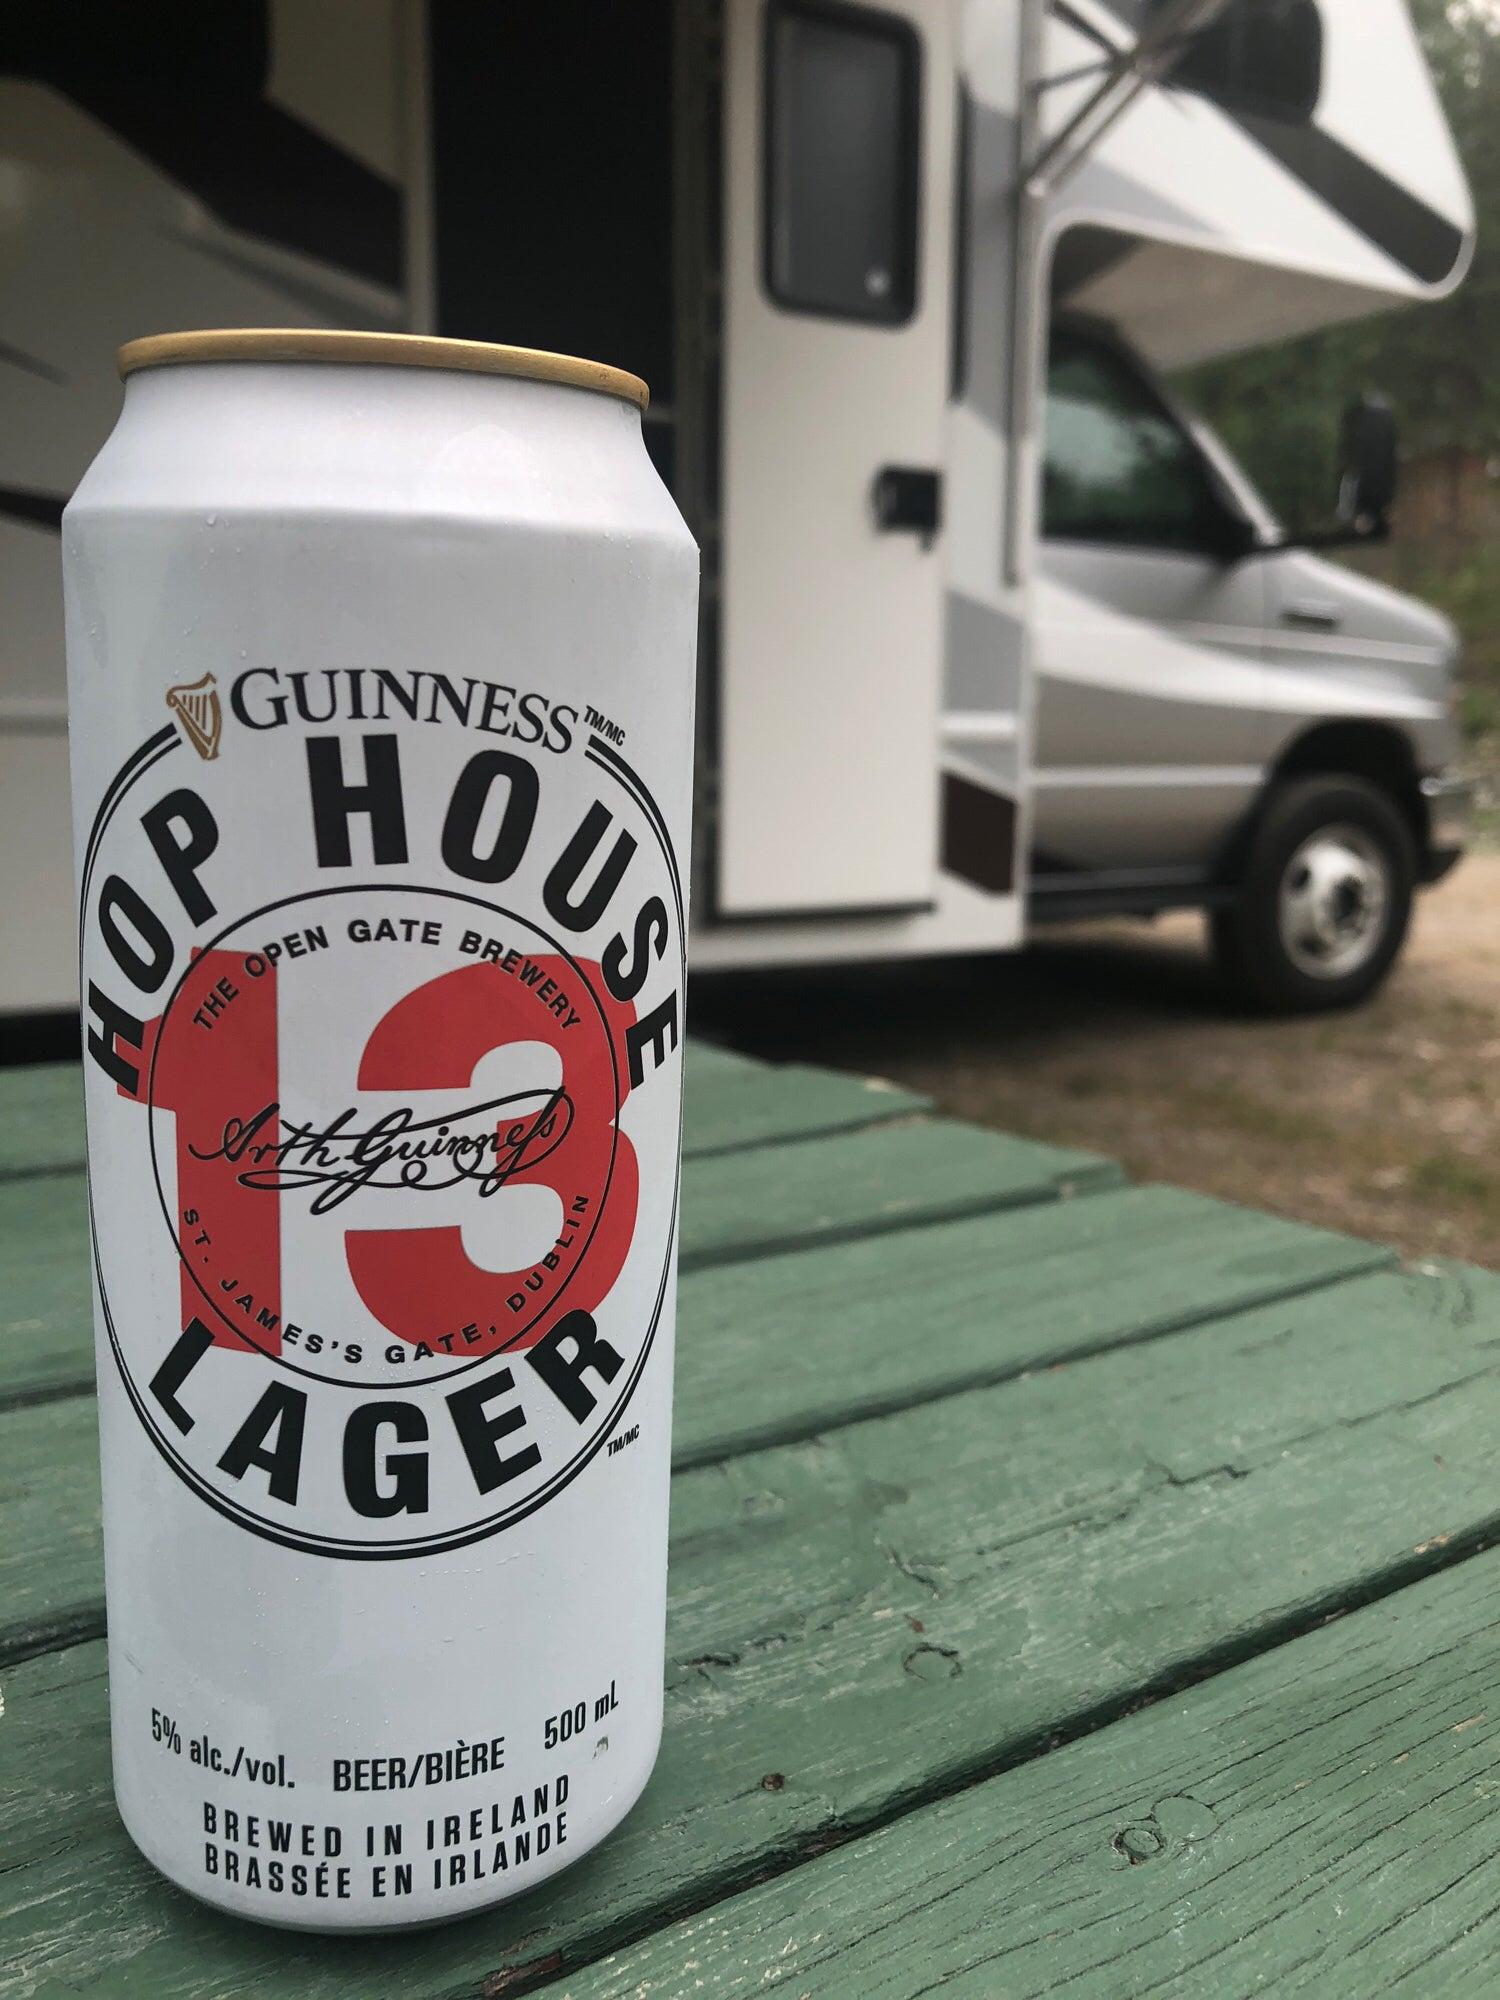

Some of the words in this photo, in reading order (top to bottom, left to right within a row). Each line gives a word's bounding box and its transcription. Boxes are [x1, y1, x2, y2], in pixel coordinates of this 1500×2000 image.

[230, 667, 578, 754] GUINNESS
[87, 788, 220, 1096] HOP
[305, 733, 679, 1091] HOUSE
[192, 976, 240, 1032] THE
[243, 924, 329, 979] OPEN
[347, 918, 443, 946] GATE
[458, 929, 582, 1031] BREWERY
[114, 947, 640, 1357] 13
[184, 1208, 209, 1264] ST.
[221, 1277, 364, 1364] JAMES'S
[384, 1324, 498, 1364] GATE,
[505, 1195, 589, 1314] DUBLIN
[148, 1308, 626, 1519] LAGER
[606, 1423, 641, 1458] TM/MC
[151, 1708, 182, 1754] 5%
[190, 1735, 296, 1789] alc./vol.
[544, 1701, 587, 1750] 500
[594, 1680, 619, 1722] mL
[333, 1736, 505, 1792] BEER/BIÈRE
[203, 1801, 342, 1857] BREWED
[366, 1825, 402, 1857] IN
[427, 1774, 570, 1850] IRELAND
[204, 1843, 351, 1898] BRASSÉE
[372, 1865, 413, 1897] EN
[434, 1811, 568, 1890] IRLANDE
